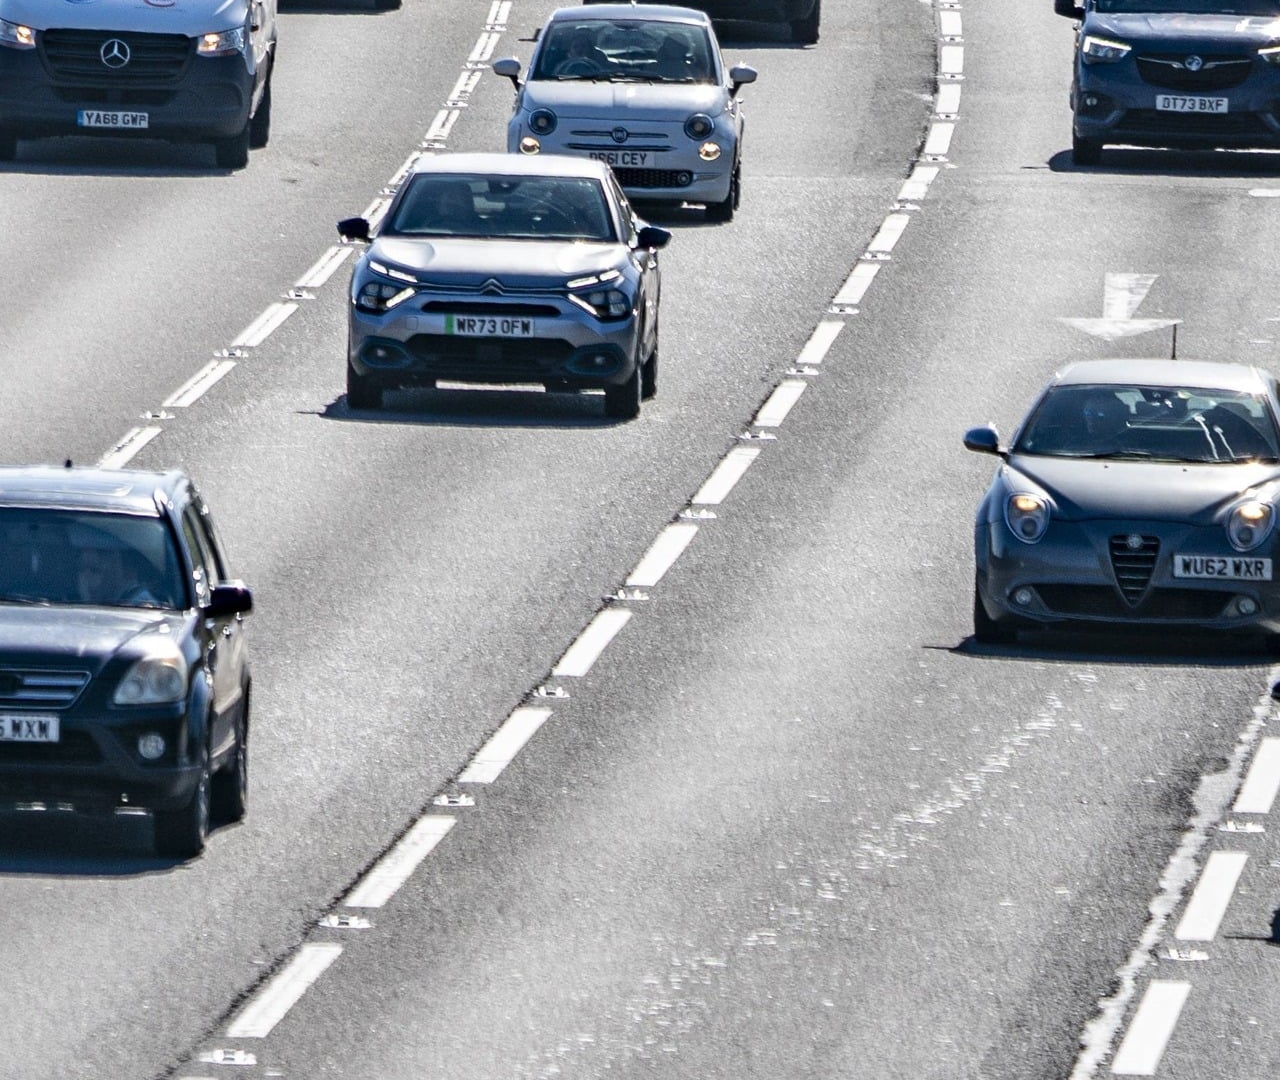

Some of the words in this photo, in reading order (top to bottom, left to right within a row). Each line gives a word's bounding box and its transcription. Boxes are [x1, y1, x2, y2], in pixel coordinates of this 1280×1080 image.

[1199, 98, 1224, 111] BXF
[622, 152, 647, 165] CEY
[457, 319, 496, 333] WR73
[1181, 558, 1227, 576] WU62
[1232, 559, 1265, 577] WXR
